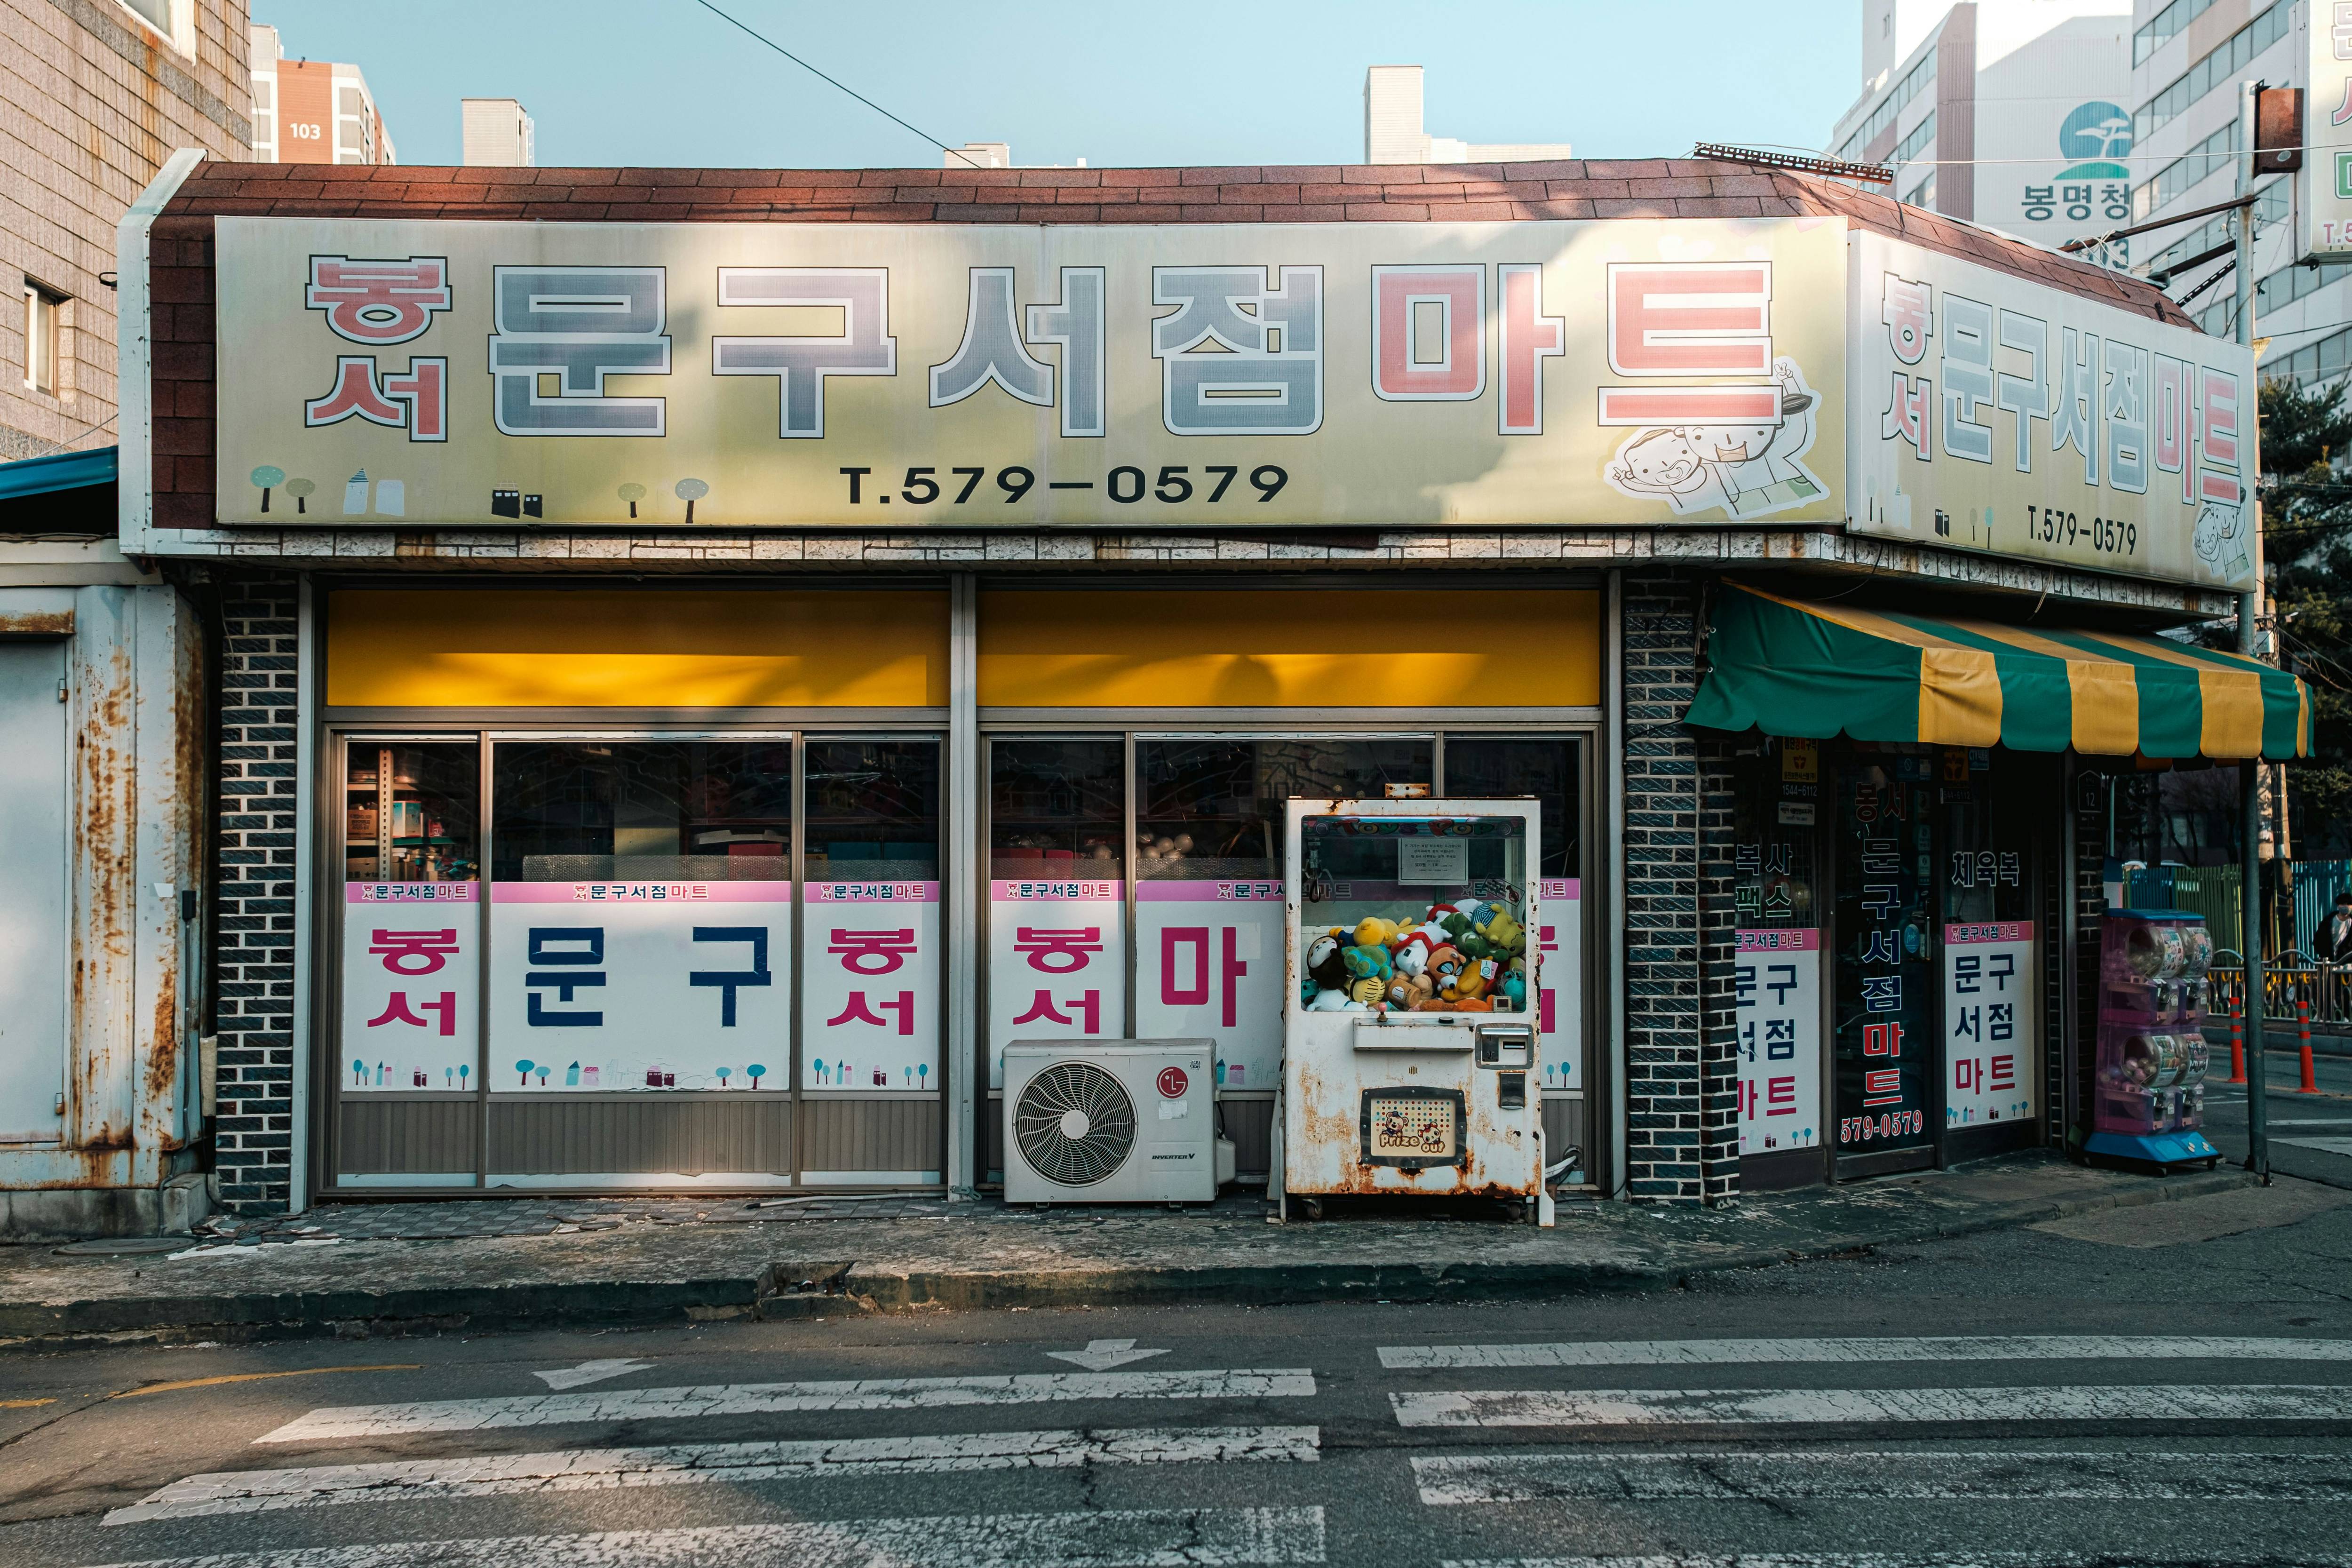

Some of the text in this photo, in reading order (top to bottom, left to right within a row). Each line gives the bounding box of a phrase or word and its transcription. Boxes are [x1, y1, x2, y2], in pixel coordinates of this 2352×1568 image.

[290, 123, 321, 140] 103
[2021, 184, 2130, 221] 봉명청
[1782, 784, 1817, 796] 1544-6112
[1855, 782, 1906, 822] 봉서
[1736, 844, 1793, 876] 복사
[1952, 851, 2019, 887] 체육복
[375, 884, 469, 900] 문구서점마트
[590, 883, 709, 900] 문구서점마트
[834, 883, 925, 899] 문구서점마트
[1019, 882, 1112, 898] 문구서점마트
[1735, 885, 1792, 918] 팩스
[1960, 924, 2018, 941] 문구서점마트
[1955, 954, 2015, 995] 문구
[1955, 1003, 2014, 1043] 서점
[1955, 1054, 2015, 1095] 마트
[1841, 1109, 1923, 1144] 579-0579
